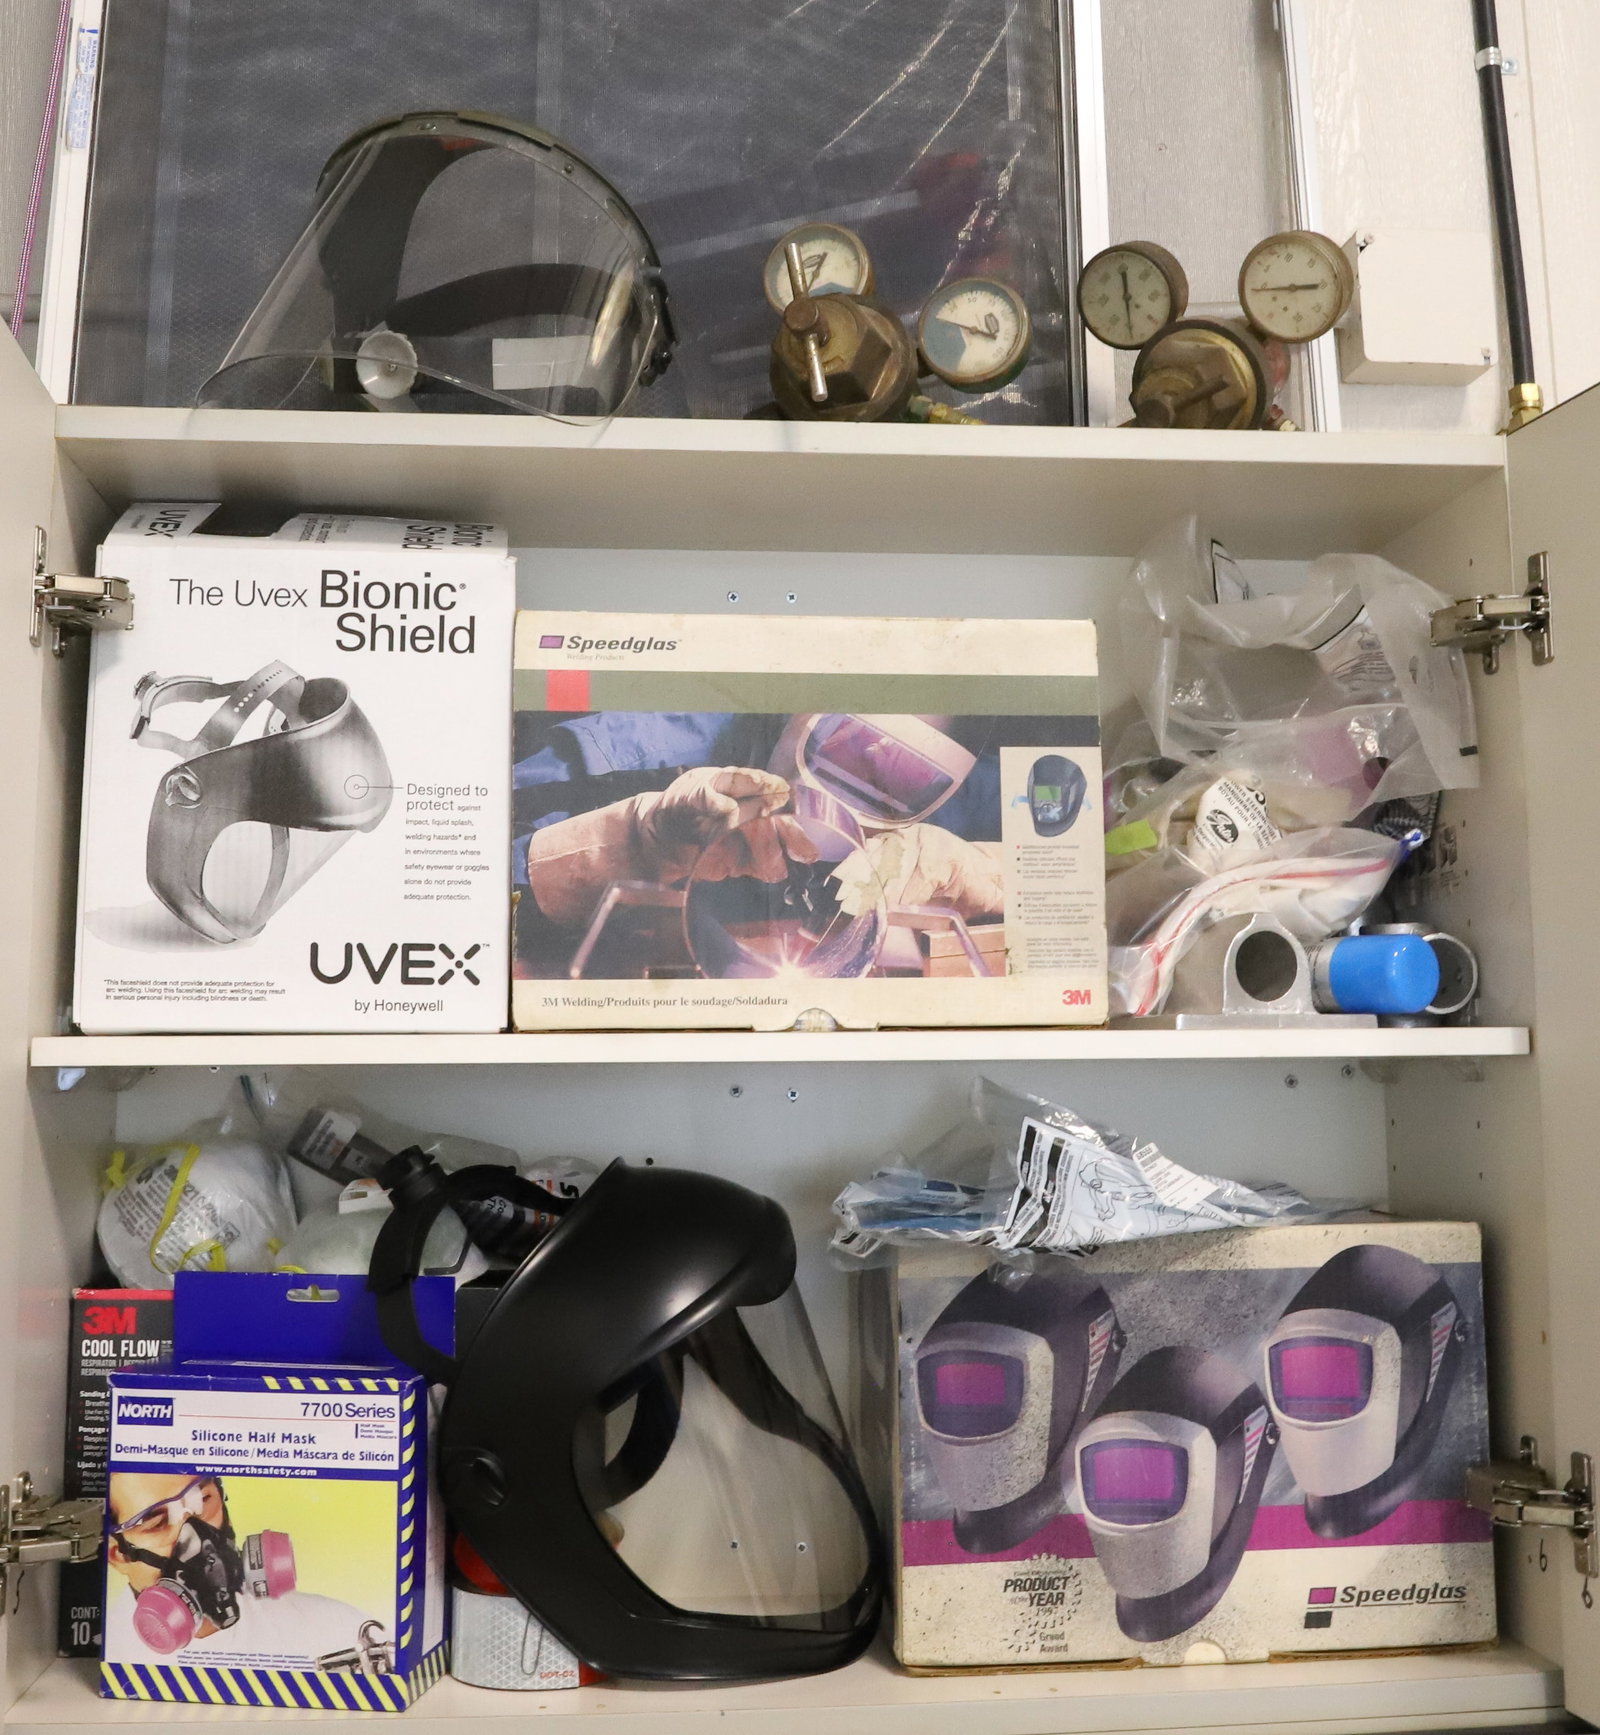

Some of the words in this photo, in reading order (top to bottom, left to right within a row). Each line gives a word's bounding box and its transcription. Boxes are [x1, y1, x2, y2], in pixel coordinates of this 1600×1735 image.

[144, 509, 190, 538] UVEX
[169, 578, 223, 607] The
[235, 579, 308, 607] Uvex
[336, 612, 476, 654] Shield
[567, 635, 677, 653] Speedglas
[407, 783, 470, 798] Designed
[475, 786, 488, 796] to
[406, 800, 454, 812] protect
[405, 833, 431, 841] welding
[404, 893, 434, 901] adequate
[310, 942, 481, 986] UVEX
[541, 997, 558, 1007] 3M
[653, 998, 677, 1008] pour
[680, 997, 689, 1006] le
[1062, 989, 1091, 1005] 3M
[354, 1000, 370, 1014] by
[374, 999, 443, 1015] Honeywell
[81, 1306, 139, 1335] 3M
[81, 1339, 117, 1357] COOL
[121, 1339, 159, 1357] FLOW
[80, 1390, 105, 1399] Sanding
[118, 1403, 173, 1419] NORTH
[300, 1402, 343, 1417] 7700
[345, 1403, 396, 1419] Series
[78, 1426, 105, 1434] Ponçage
[192, 1429, 243, 1442] Silicone
[248, 1431, 276, 1443] Half
[281, 1432, 316, 1445] Mask
[115, 1443, 188, 1458] Demi-Masque
[192, 1447, 205, 1455] en
[293, 1448, 338, 1460] Máscara
[342, 1450, 355, 1460] de
[359, 1450, 394, 1462] Silicón
[195, 1465, 317, 1477] www.northsafety.com
[1003, 1576, 1071, 1593] PRODUCT
[1029, 1592, 1065, 1607] YEAR
[1340, 1582, 1467, 1607] Speedglas
[71, 1606, 100, 1620] CONT:
[71, 1621, 90, 1646] 10
